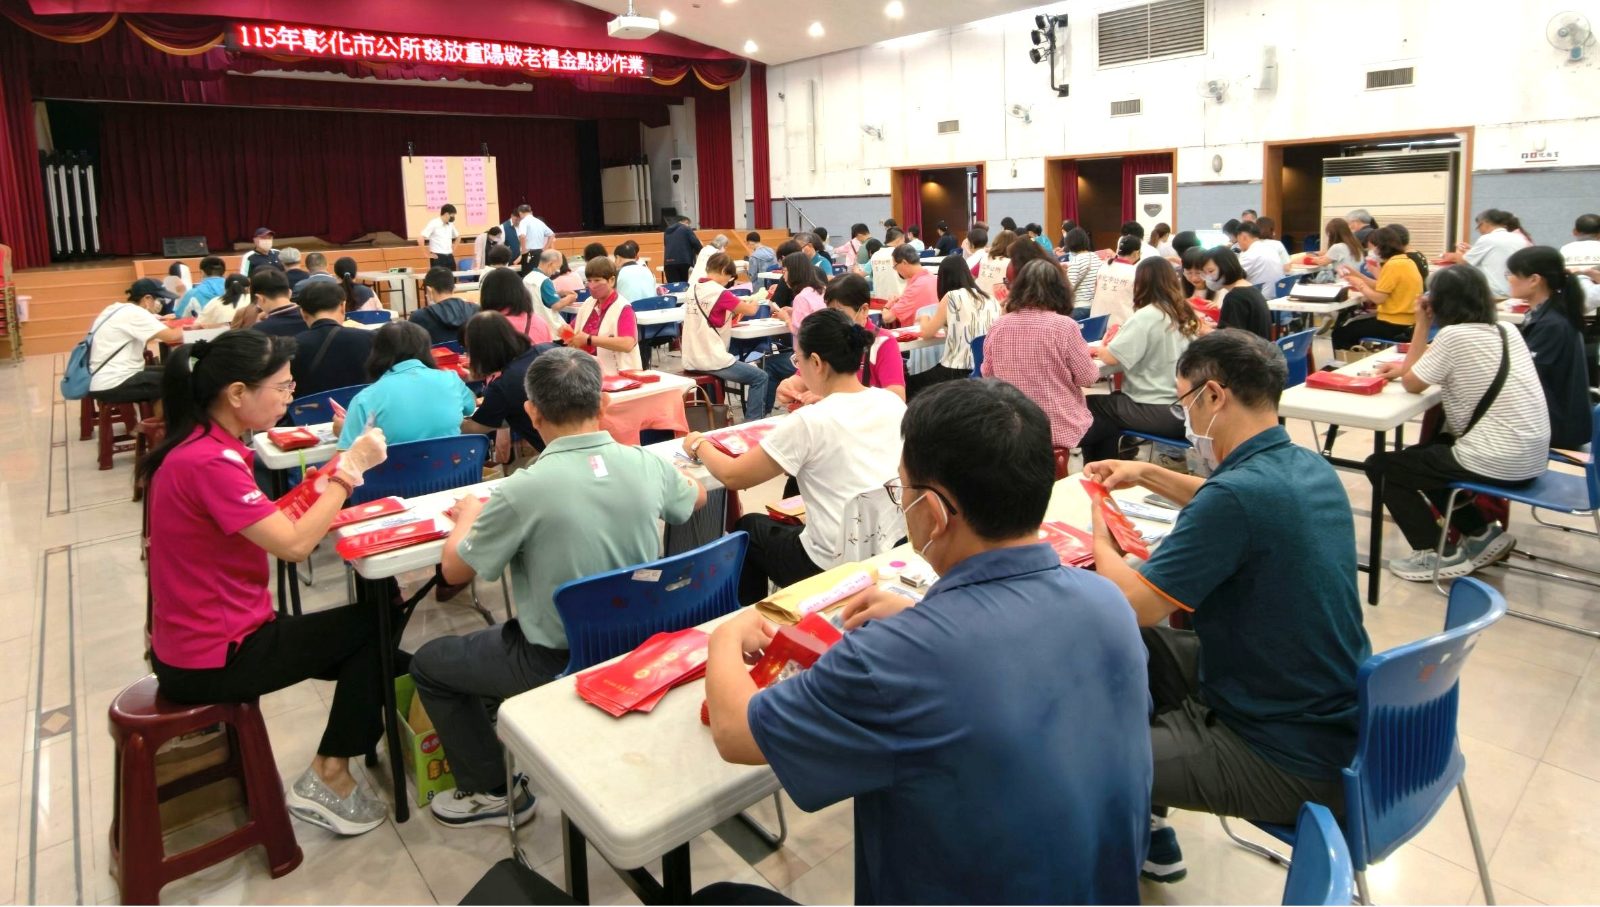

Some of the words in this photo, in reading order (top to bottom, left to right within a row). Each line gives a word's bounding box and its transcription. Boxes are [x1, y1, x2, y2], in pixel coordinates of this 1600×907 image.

[240, 25, 645, 75] 115年彰化市公所發放重陽敬老禮金點鈔作業
